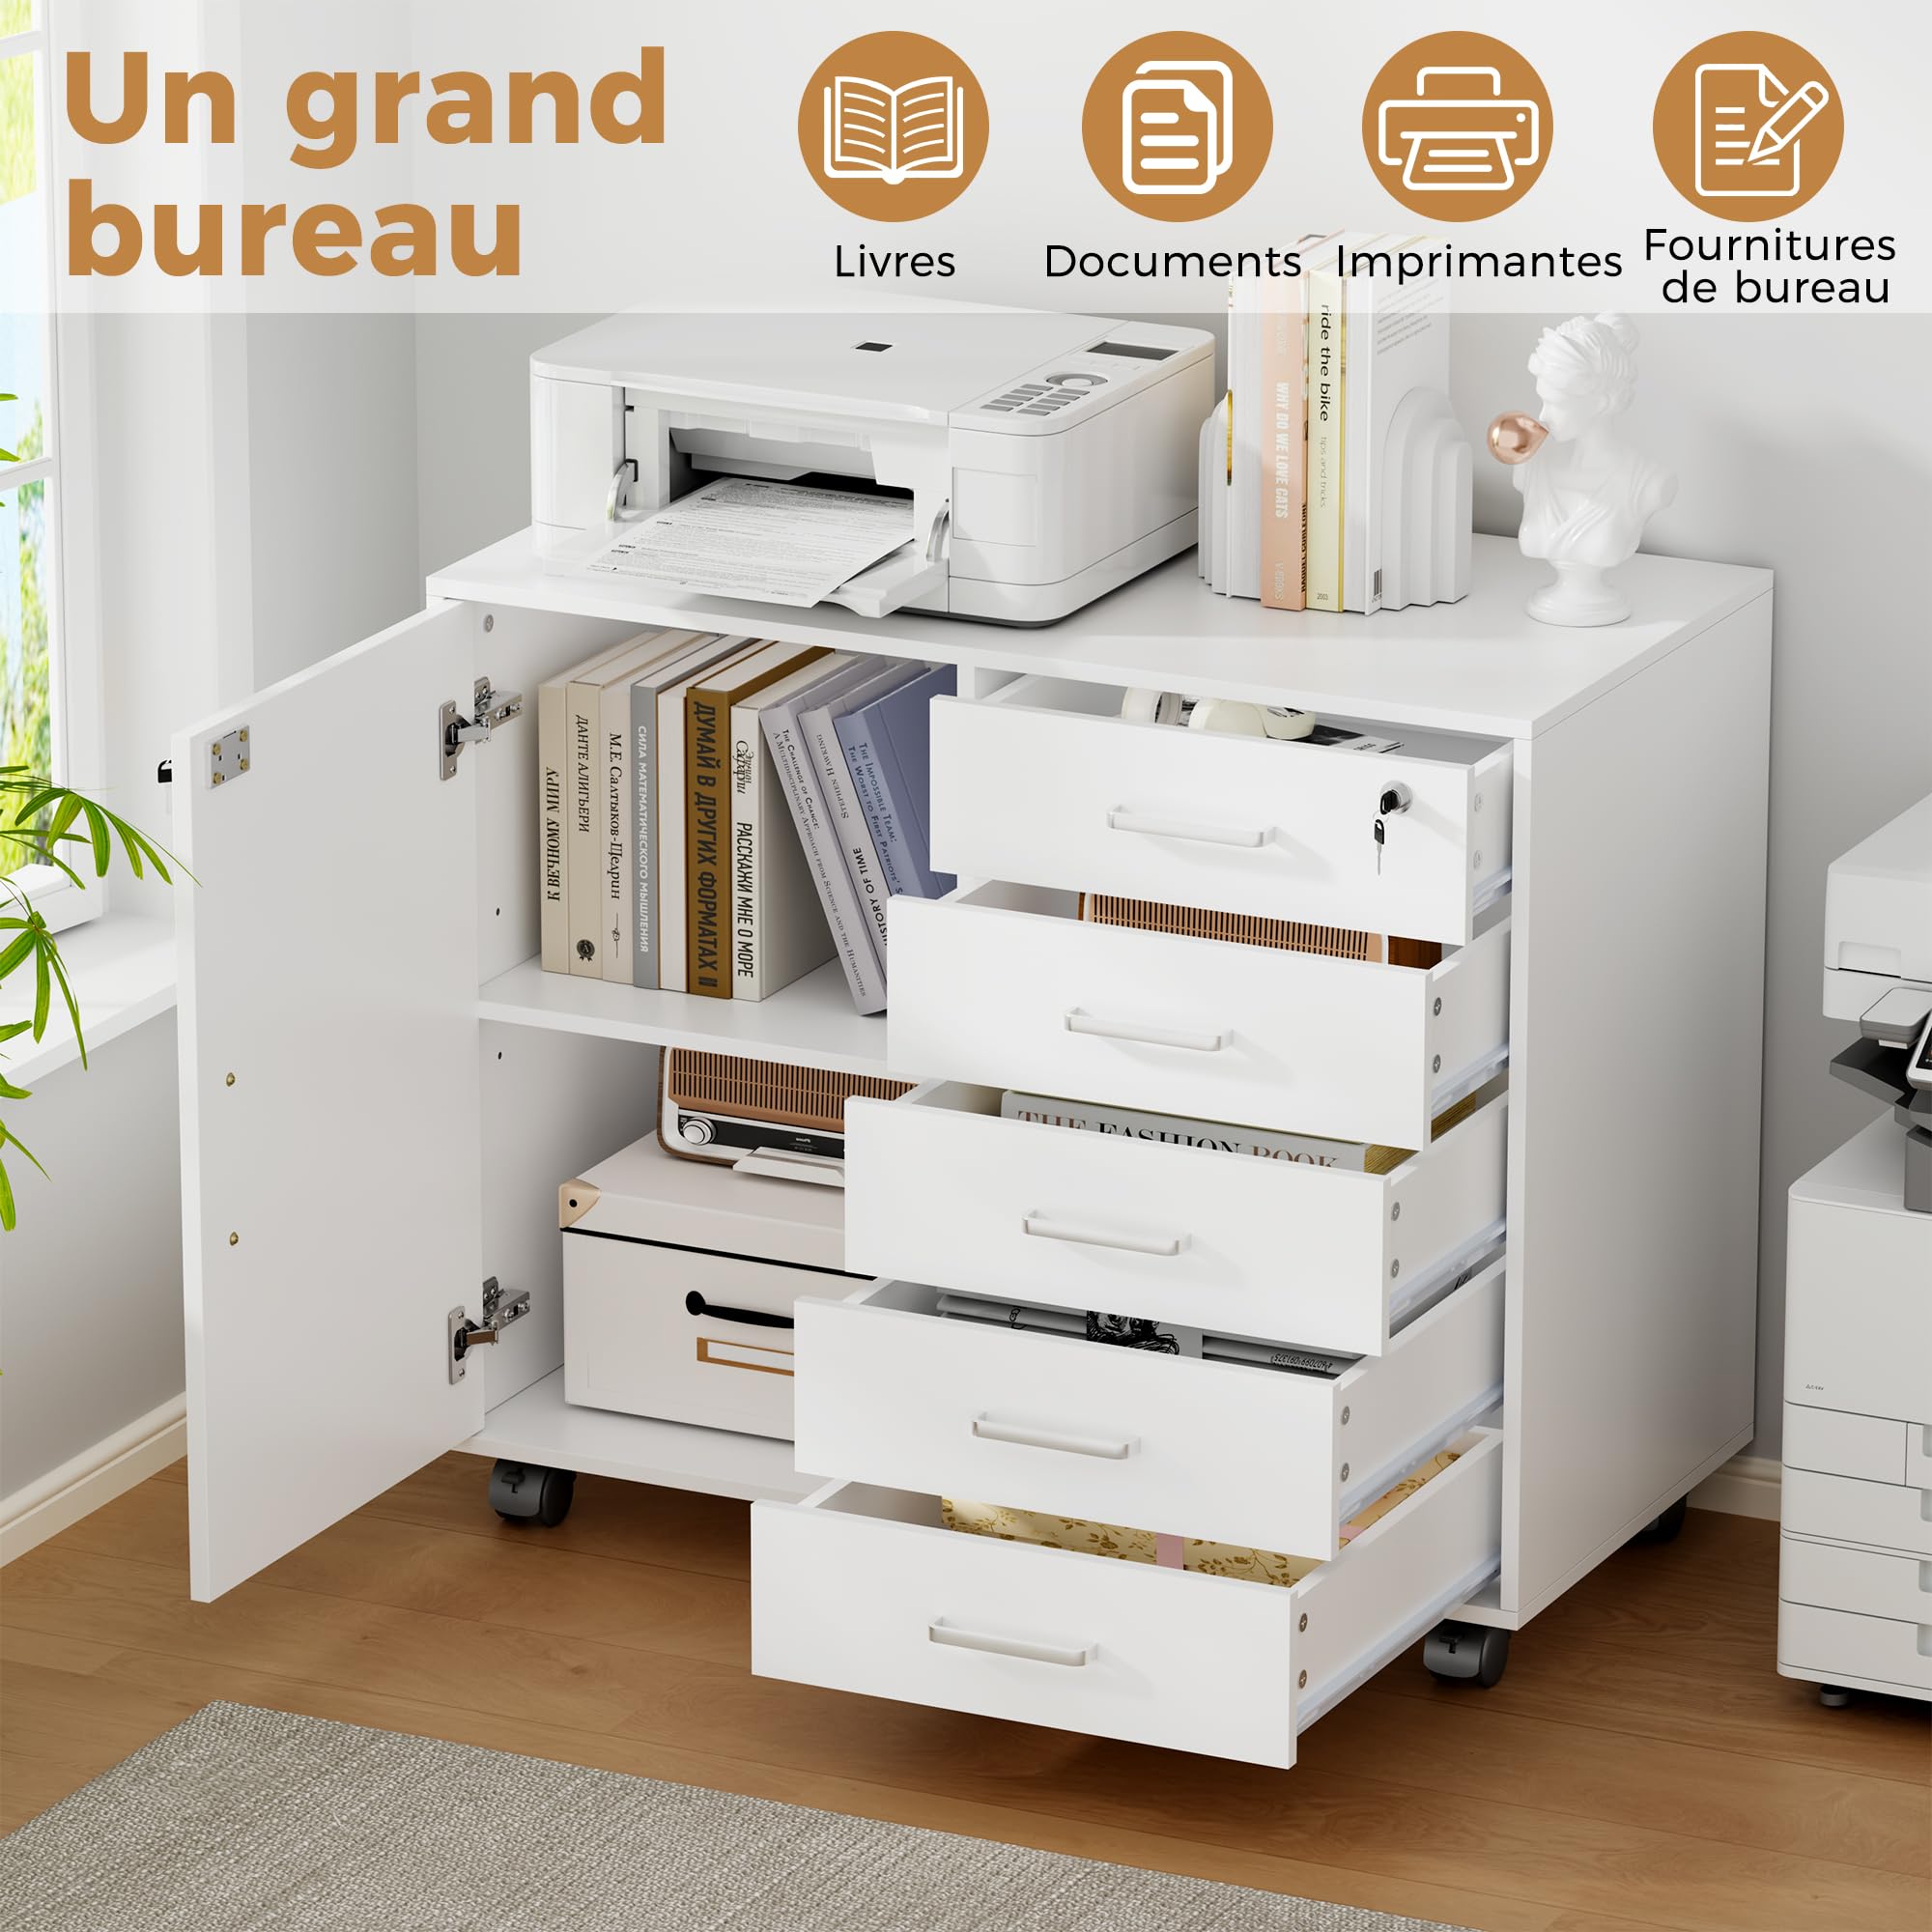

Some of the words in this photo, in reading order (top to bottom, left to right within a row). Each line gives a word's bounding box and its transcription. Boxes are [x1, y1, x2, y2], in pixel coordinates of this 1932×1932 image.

[1321, 303, 1332, 341] ride
[1321, 346, 1331, 377] the
[1275, 382, 1290, 411] WHY
[1320, 383, 1331, 422] bike
[1275, 412, 1290, 430] DO
[1275, 433, 1290, 452] WE
[1320, 436, 1328, 455] tips
[1275, 455, 1290, 485] LOVE
[1320, 457, 1328, 479] and
[1275, 487, 1290, 519] CATS
[1320, 481, 1328, 508] tricks
[575, 714, 589, 760] ДАНТЕ
[610, 732, 622, 763] М.Е.
[638, 725, 648, 758] СИЛА
[694, 700, 721, 770] ДУМАЙ
[816, 734, 835, 777] HAWKING
[546, 766, 560, 813] МИРУ
[696, 775, 717, 787] В
[854, 765, 869, 798] WORST
[865, 762, 887, 812] IMPOSSIBLE
[578, 762, 590, 834] АЛИГЬЕРИ
[831, 779, 849, 819] STEPHEN
[607, 766, 623, 900] Салтыков-Щедрин
[638, 762, 649, 879] МАТЕМАТИЧЕСКОГО
[694, 791, 718, 867] ДРУГИХ
[546, 817, 560, 888] ВЕЧНОМУ
[736, 822, 753, 895] РАССКАЖИ
[852, 847, 868, 875] TIME
[547, 891, 560, 902] К
[863, 877, 875, 894] OF
[639, 882, 649, 952] МЫШЛЕНИЯ
[697, 871, 719, 972] ФОРМАТАХ
[737, 896, 753, 926] МНЕ
[737, 928, 753, 938] О
[737, 940, 753, 979] МОРЕ
